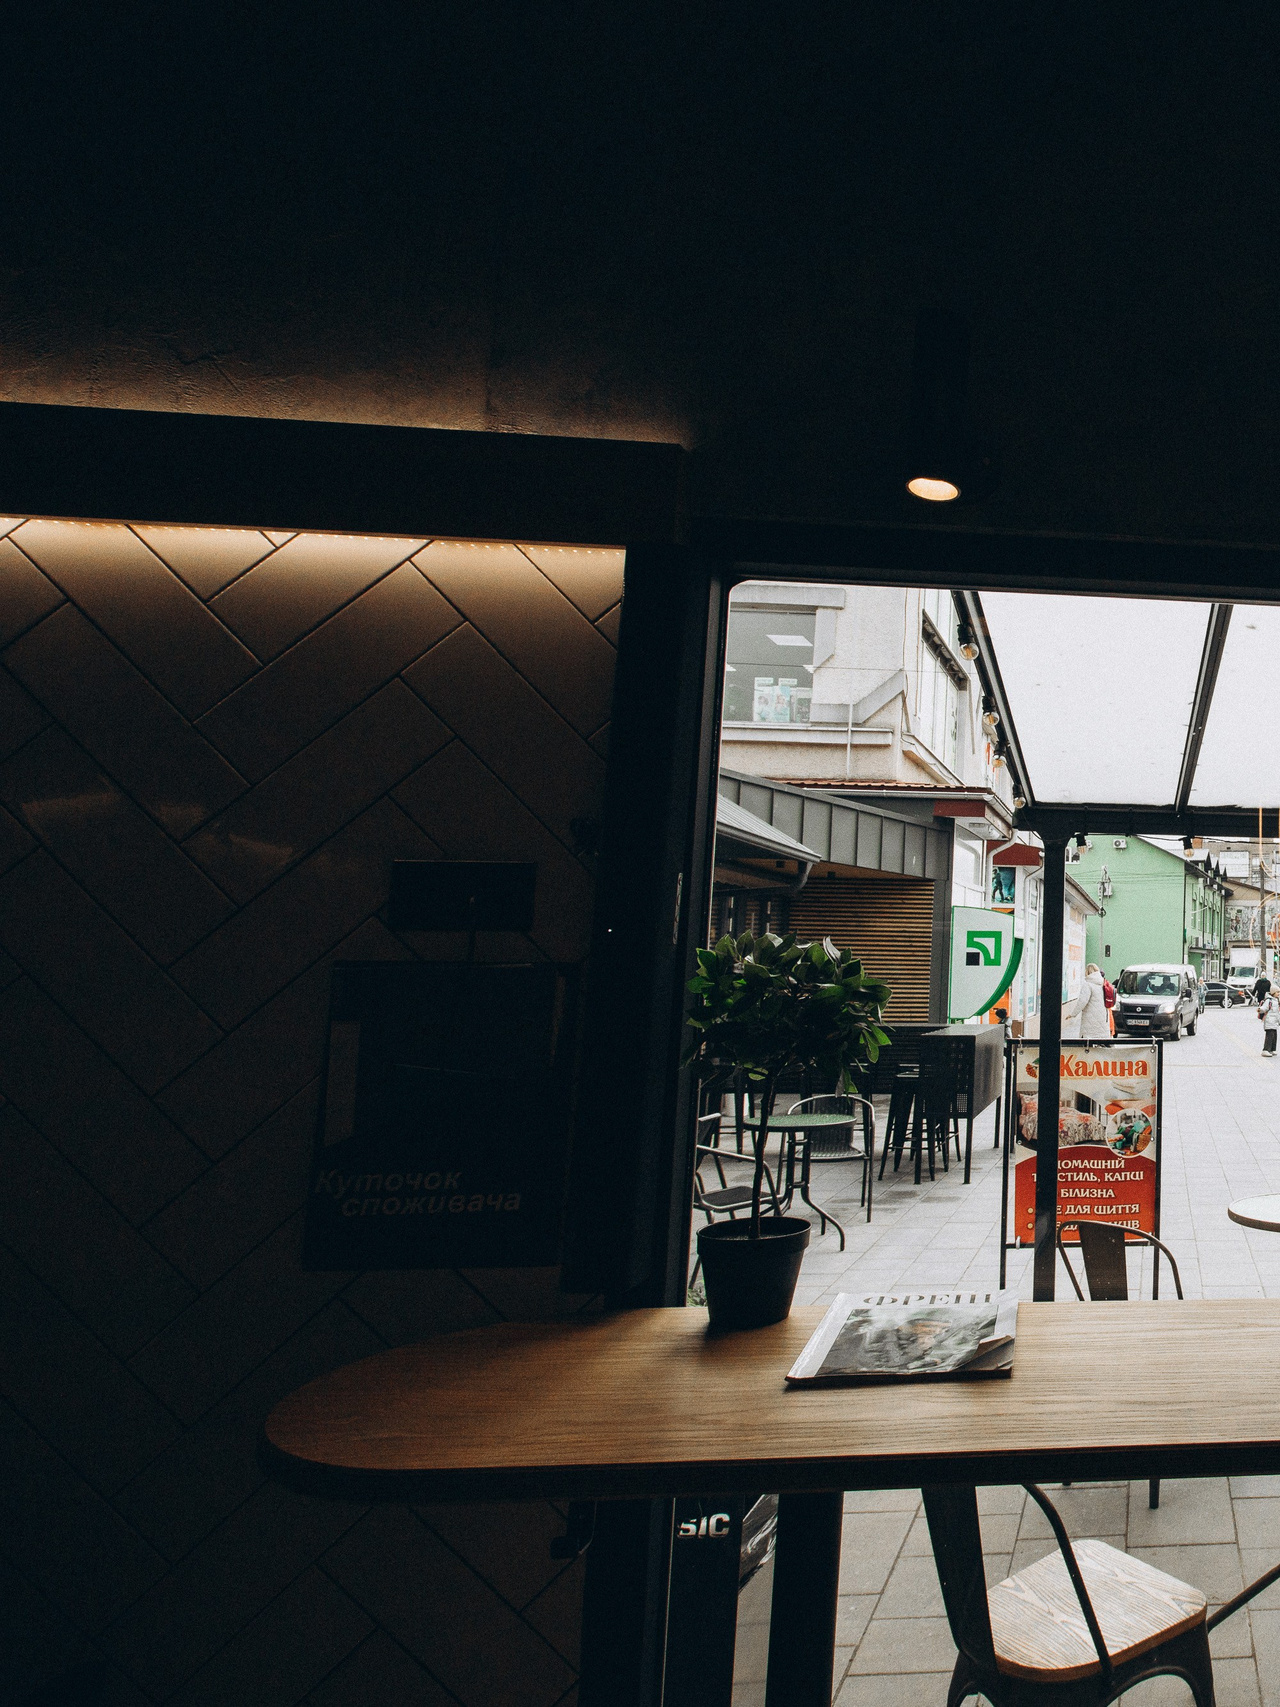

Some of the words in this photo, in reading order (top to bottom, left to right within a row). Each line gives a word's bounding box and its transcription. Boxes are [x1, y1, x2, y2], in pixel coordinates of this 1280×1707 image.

[1060, 1054, 1148, 1077] Калина
[1057, 1158, 1125, 1169] ОМАШНІЙ
[1032, 1172, 1101, 1182] ТСТИЛЬ,
[1104, 1171, 1144, 1181] КАПЦІ
[315, 1169, 463, 1198] Куточок
[1060, 1188, 1115, 1198] БІЛИЗНА
[341, 1189, 521, 1217] споживача
[1065, 1204, 1091, 1215] ДЛЯ
[1094, 1204, 1140, 1214] ШИТТЯ
